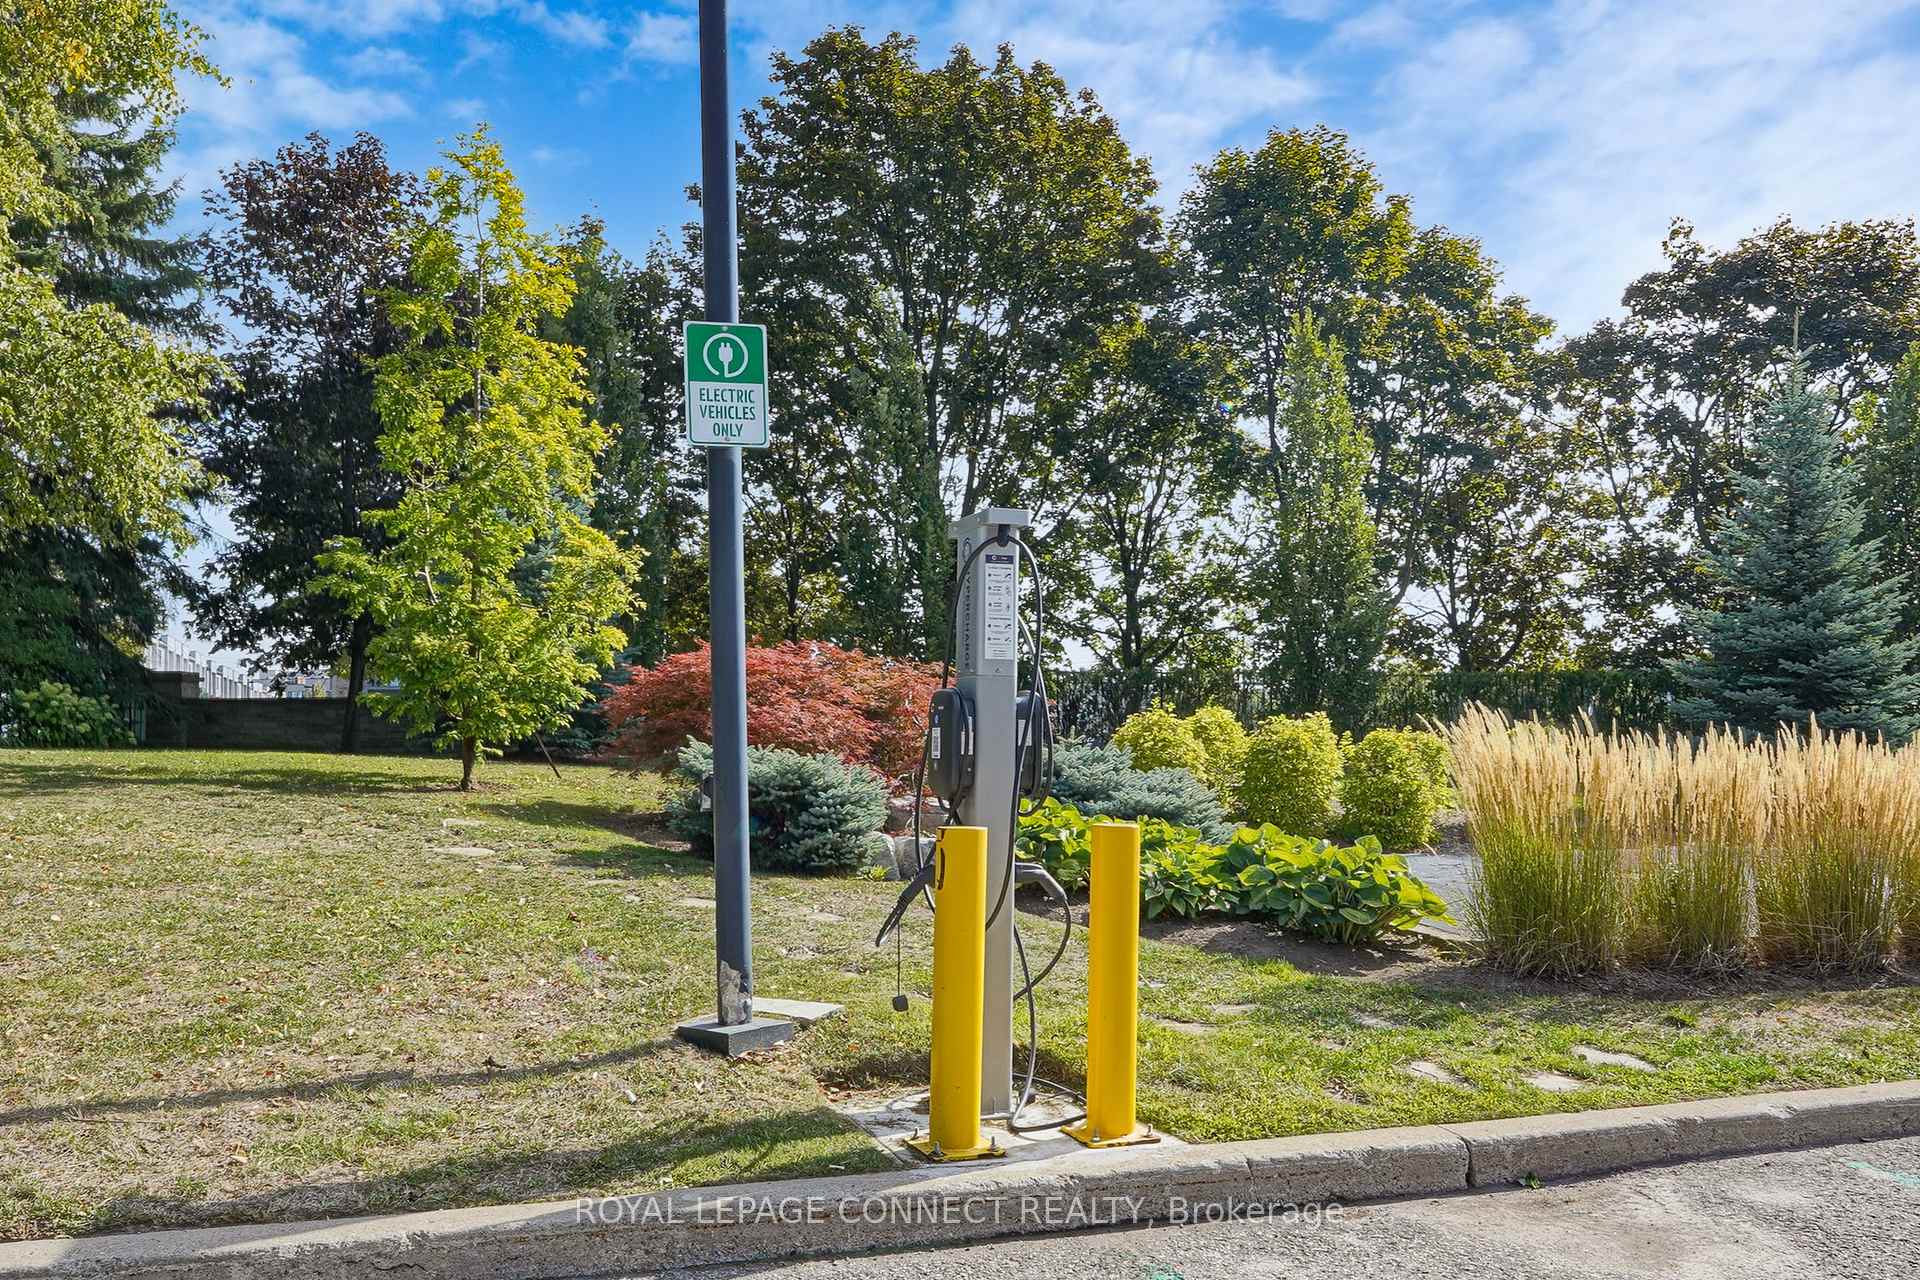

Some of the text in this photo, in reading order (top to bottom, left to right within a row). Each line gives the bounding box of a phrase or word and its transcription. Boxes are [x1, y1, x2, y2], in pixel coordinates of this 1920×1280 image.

[699, 388, 755, 403] ELECTRIC
[699, 404, 755, 420] VEHICLES
[713, 422, 743, 437] ONLY
